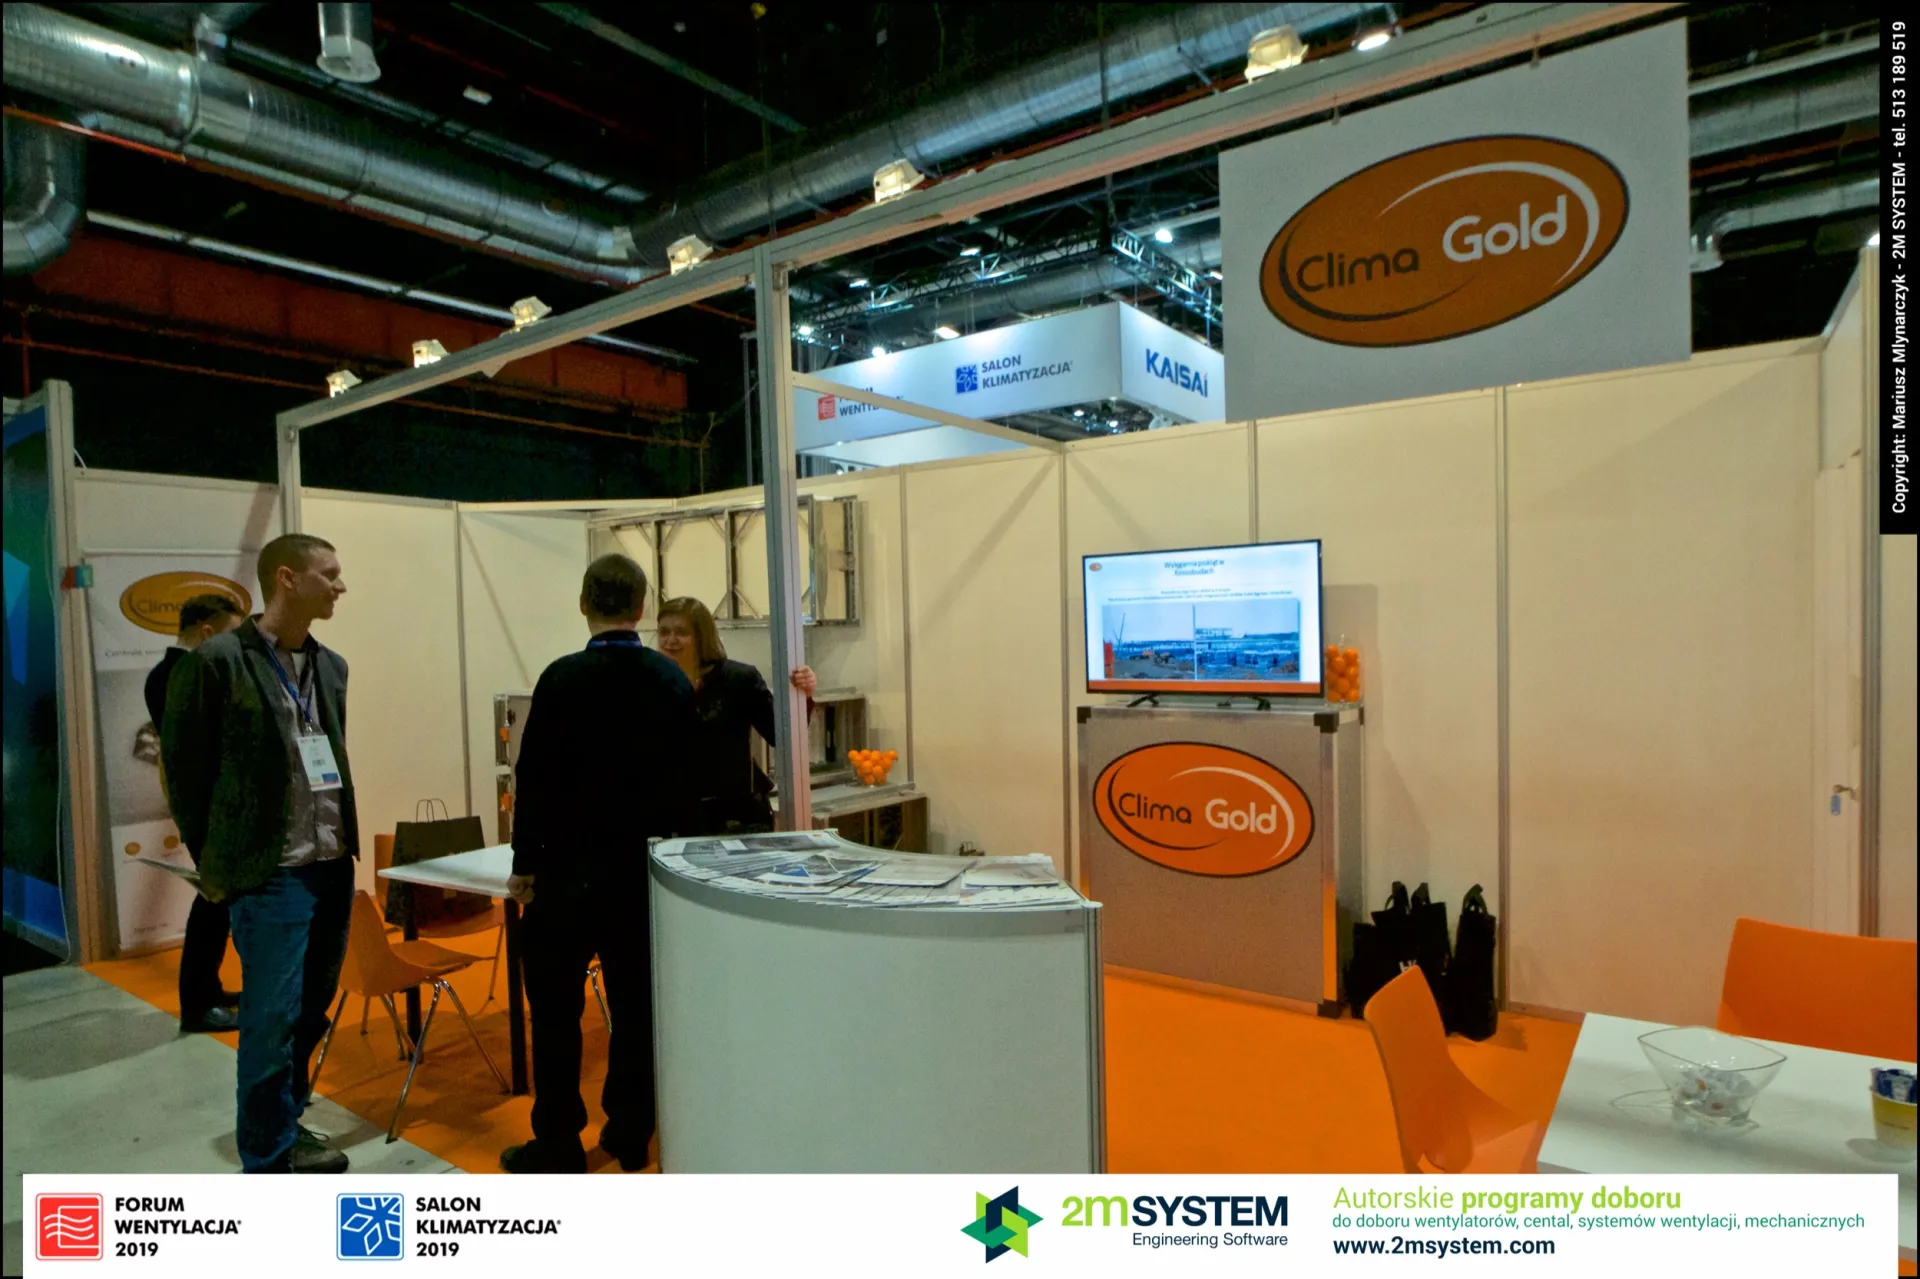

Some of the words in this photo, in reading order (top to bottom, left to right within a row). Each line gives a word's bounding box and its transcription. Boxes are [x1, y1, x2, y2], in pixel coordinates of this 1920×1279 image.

[1297, 247, 1419, 292] Clima
[1442, 194, 1567, 262] Gold
[982, 354, 1021, 373] SALON
[1146, 348, 1208, 398] KAISAI
[1118, 792, 1192, 824] Clima
[1205, 798, 1277, 835] Gold
